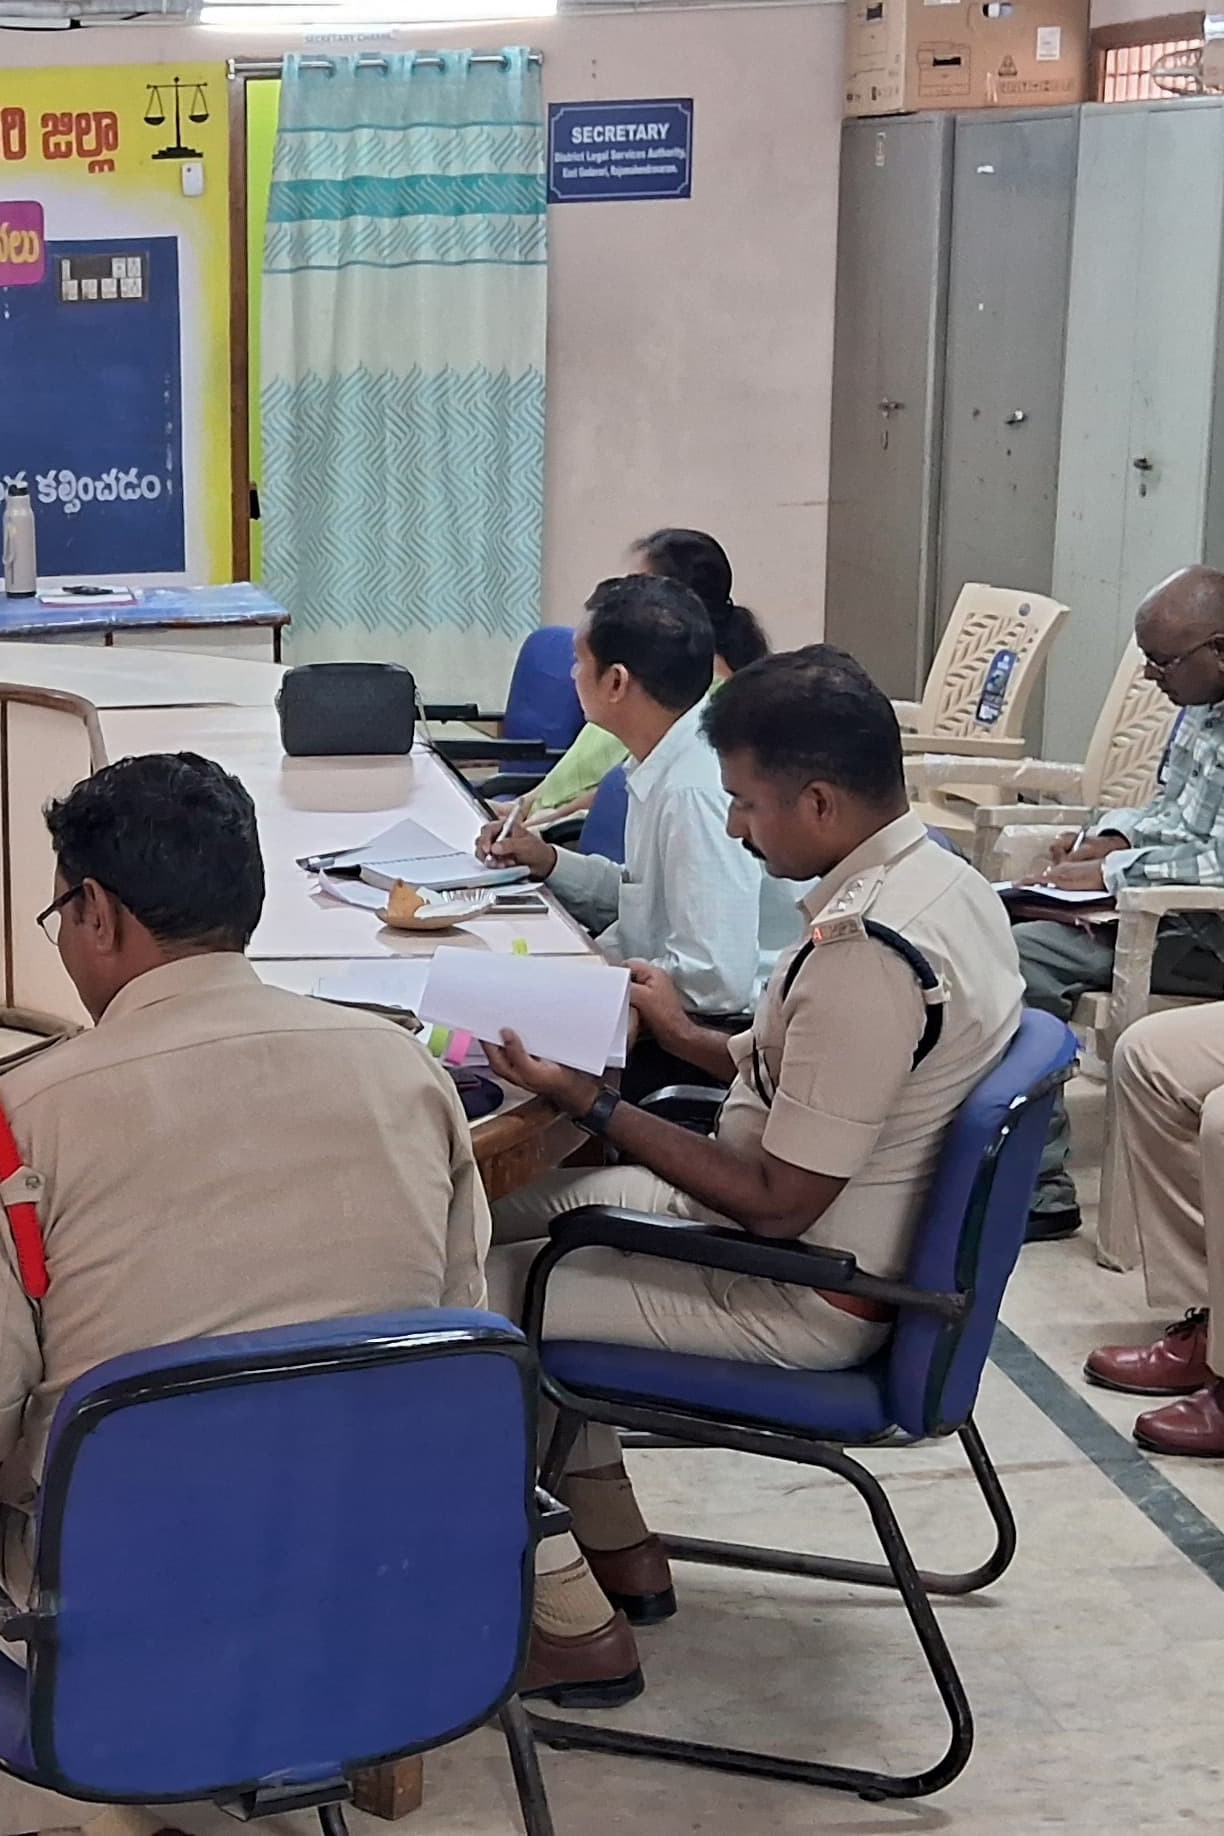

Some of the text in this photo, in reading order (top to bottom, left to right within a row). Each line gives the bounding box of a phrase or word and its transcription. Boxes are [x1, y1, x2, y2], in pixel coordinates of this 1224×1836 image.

[40, 110, 119, 174] జిల్లా
[571, 122, 670, 144] SECRETARY
[586, 150, 609, 164] Legal
[610, 149, 646, 161] Services
[35, 467, 162, 514] కల్పించడం
